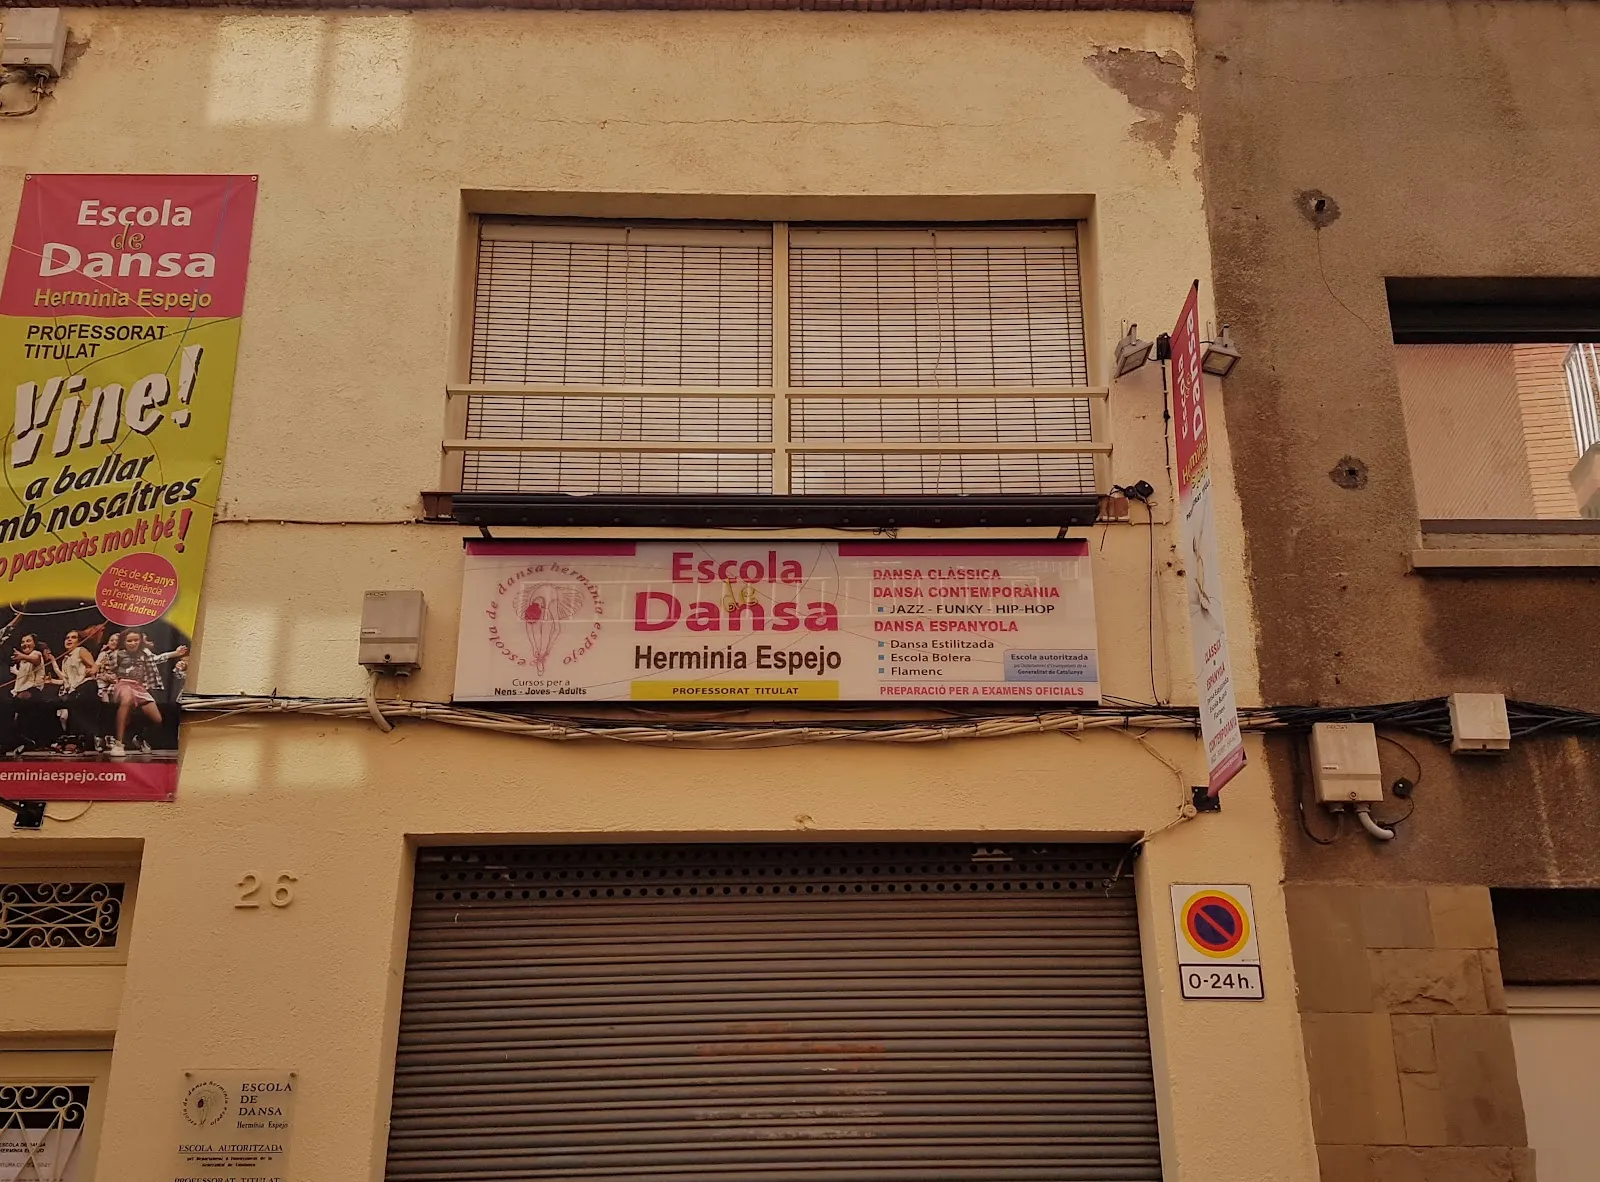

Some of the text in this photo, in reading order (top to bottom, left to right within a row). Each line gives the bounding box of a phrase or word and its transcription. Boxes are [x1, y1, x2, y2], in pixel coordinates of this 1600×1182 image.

[77, 199, 192, 226] Escola
[110, 223, 146, 251] de
[39, 242, 216, 278] Dansa
[33, 288, 212, 312] Herminia Espejo
[26, 323, 167, 341] PROFESSORAT
[24, 343, 100, 360] TITULAT
[1186, 309, 1204, 441] Dansa
[1177, 353, 1189, 440] Escola
[11, 343, 204, 469] Vine!
[25, 453, 155, 501] a ballar
[47, 478, 201, 532] nosaltres
[8, 531, 99, 582] passaràs
[101, 518, 148, 553] molt
[151, 508, 193, 553] bé!
[672, 551, 803, 583] Escola
[873, 566, 1001, 580] DANSA CLÀSSICA
[109, 566, 176, 588] més de 45 anys
[114, 578, 163, 596] d'experiència
[721, 577, 759, 613] de
[873, 584, 1060, 598] DANSA CONTEMPORÀNIA
[102, 588, 166, 607] en l'ensenyament
[108, 599, 128, 611] Sant
[127, 603, 157, 617] Andreu
[486, 601, 499, 620] de
[498, 564, 545, 595] dansa
[563, 621, 603, 666] espejo
[634, 591, 839, 632] Dansa
[890, 604, 925, 614] JAZZ
[936, 604, 983, 614] FUNKY
[995, 604, 1055, 614] HIP-HOP
[874, 620, 1019, 632] DANSA ESPANYOLA
[890, 639, 995, 649] Dansa Estilitzada
[634, 645, 842, 675] Herminia Espejo
[891, 653, 972, 662] Escola Bolera
[1039, 653, 1089, 661] autoritzada
[891, 666, 944, 676] Flamenc
[494, 687, 517, 696] Nens
[525, 687, 551, 695] Joves
[559, 686, 587, 695] Adults
[512, 678, 545, 687] Cursos
[546, 679, 564, 688] per
[672, 687, 799, 695] PROFESSORAT TITULAT
[880, 684, 1084, 695] PREPARACIÓ PER A EXAMENS OFICIALS
[235, 869, 298, 909] 26
[241, 1083, 293, 1092] ESCOLA
[240, 1095, 258, 1104] DE
[238, 1107, 283, 1116] DANSA
[268, 1120, 289, 1130] Espejo
